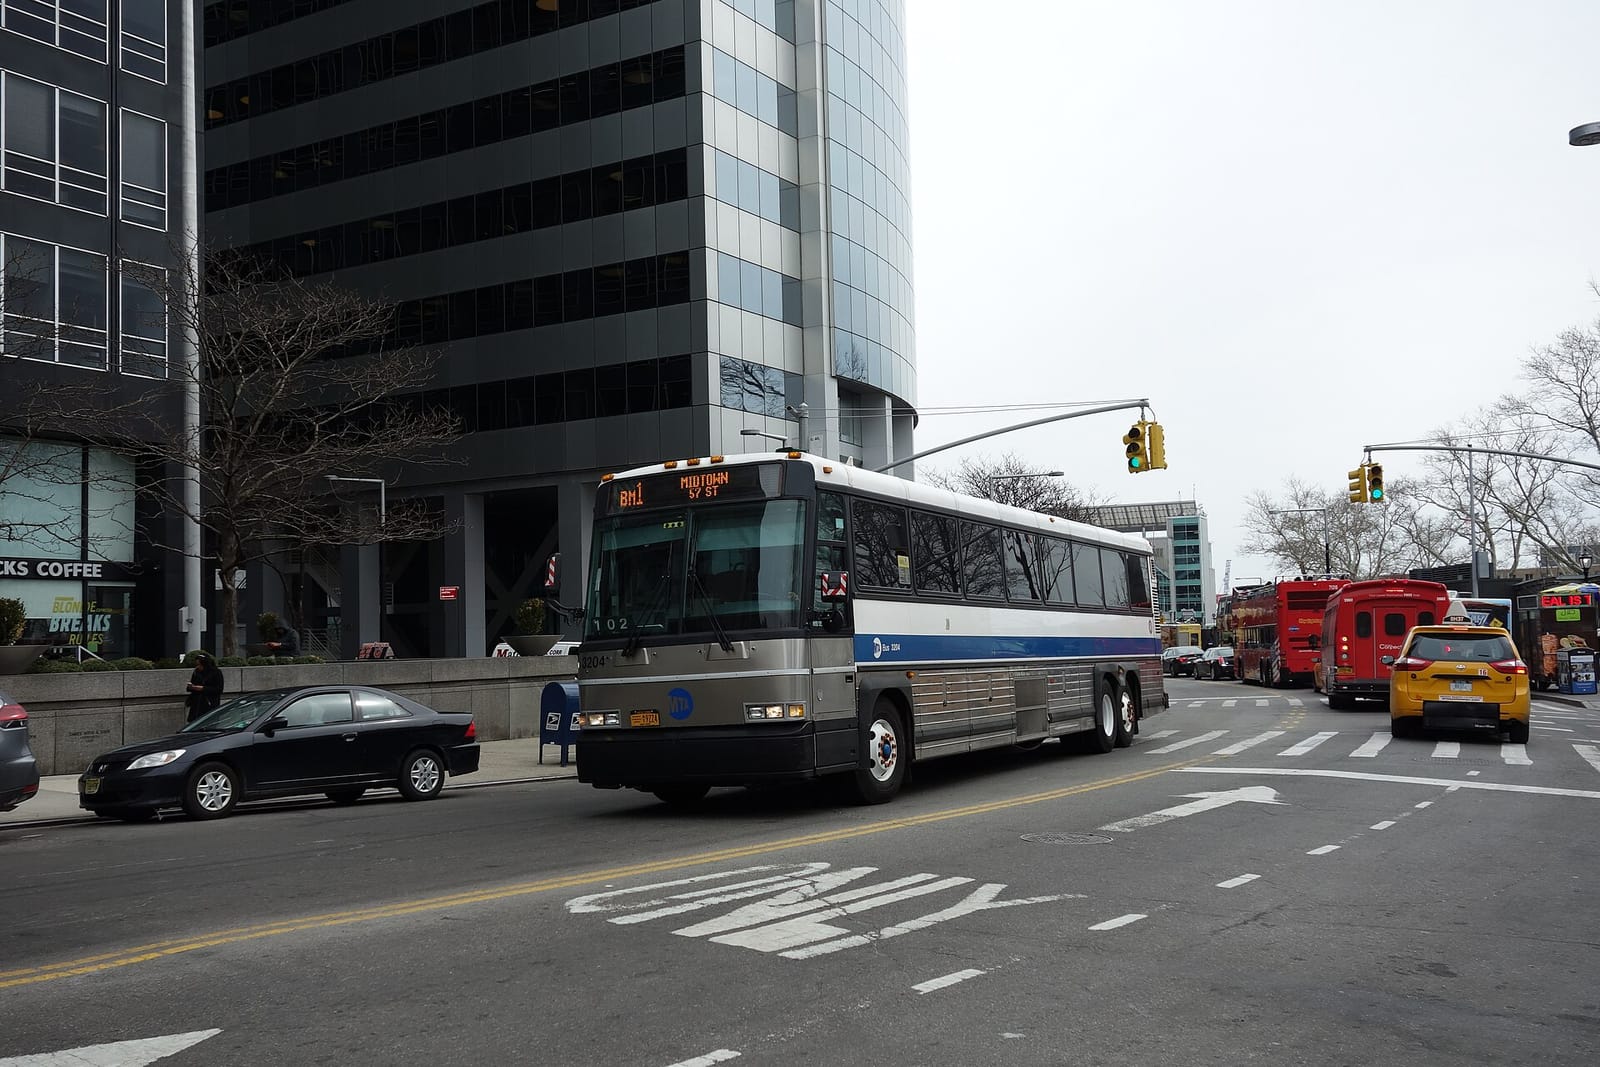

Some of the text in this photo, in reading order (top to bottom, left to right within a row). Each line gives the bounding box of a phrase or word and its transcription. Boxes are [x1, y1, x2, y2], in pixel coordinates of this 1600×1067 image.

[680, 472, 729, 489] MIDTOWN
[619, 482, 644, 507] BM1
[689, 485, 719, 499] 57 ST
[36, 561, 102, 578] COFFEE
[53, 600, 97, 614] BLONE
[581, 655, 605, 669] 3204
[565, 861, 1088, 960] ONLY
